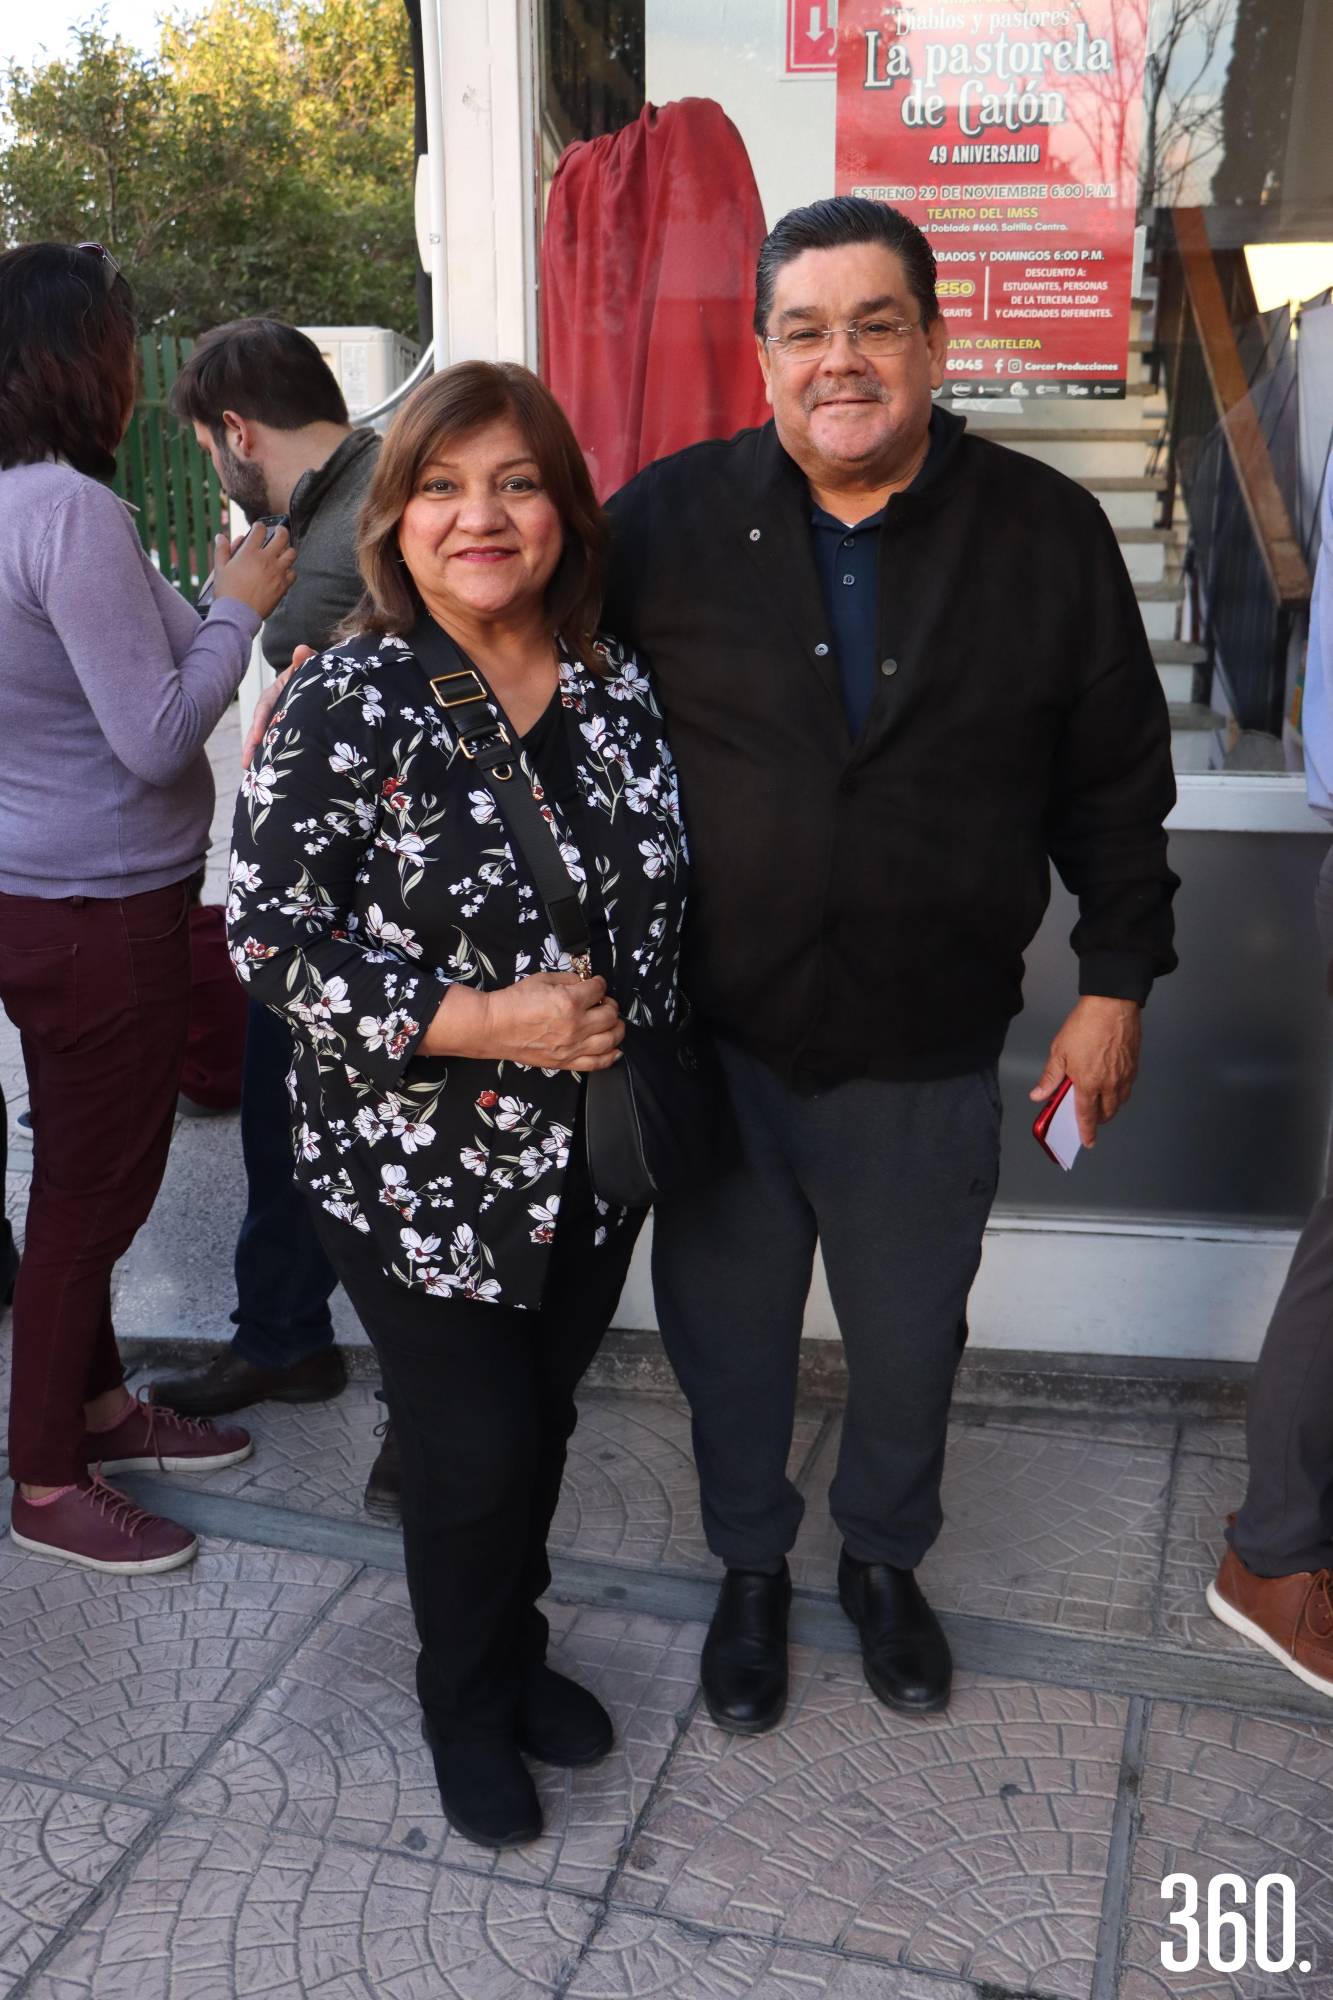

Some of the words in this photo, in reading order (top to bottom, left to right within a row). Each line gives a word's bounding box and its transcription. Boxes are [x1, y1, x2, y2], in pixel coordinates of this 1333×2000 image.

[969, 12, 984, 35] y
[864, 29, 911, 89] La
[925, 23, 1113, 89] pastorela
[901, 80, 945, 128] de
[957, 77, 1067, 137] Catón
[928, 146, 949, 165] 49
[951, 143, 1041, 165] ANIVERSARIO
[852, 186, 917, 201] ESTRENO
[919, 186, 938, 200] 29
[941, 186, 961, 200] DE
[963, 184, 1047, 200] NOVIEMBRE
[1050, 184, 1082, 199] 6:00
[927, 207, 976, 220] TEATRO
[979, 207, 1003, 219] DEL
[1006, 206, 1039, 218] IMSS
[932, 249, 976, 262] ÁBADOS
[979, 251, 987, 262] Y
[989, 250, 1051, 261] DOMINGOS
[1053, 250, 1078, 260] 6:00
[1081, 250, 1105, 260] P.M.
[1025, 267, 1075, 278] DESCUENTO
[1076, 267, 1087, 277] A:
[935, 280, 975, 297] 250
[1002, 281, 1062, 292] ESTUDIANTES,
[1063, 281, 1109, 291] PERSONAS
[1011, 295, 1022, 305] DE
[1024, 295, 1035, 305] LA
[1036, 295, 1073, 305] TERCERA
[1075, 295, 1099, 304] EDAD
[942, 308, 973, 318] GRATIS
[995, 309, 1001, 318] Y
[1002, 308, 1059, 319] CAPACIDADES
[1060, 309, 1113, 318] DIFERENTES.
[975, 339, 1042, 350] CARTELERA
[945, 359, 983, 371] 6045
[1056, 361, 1119, 371] Producciones
